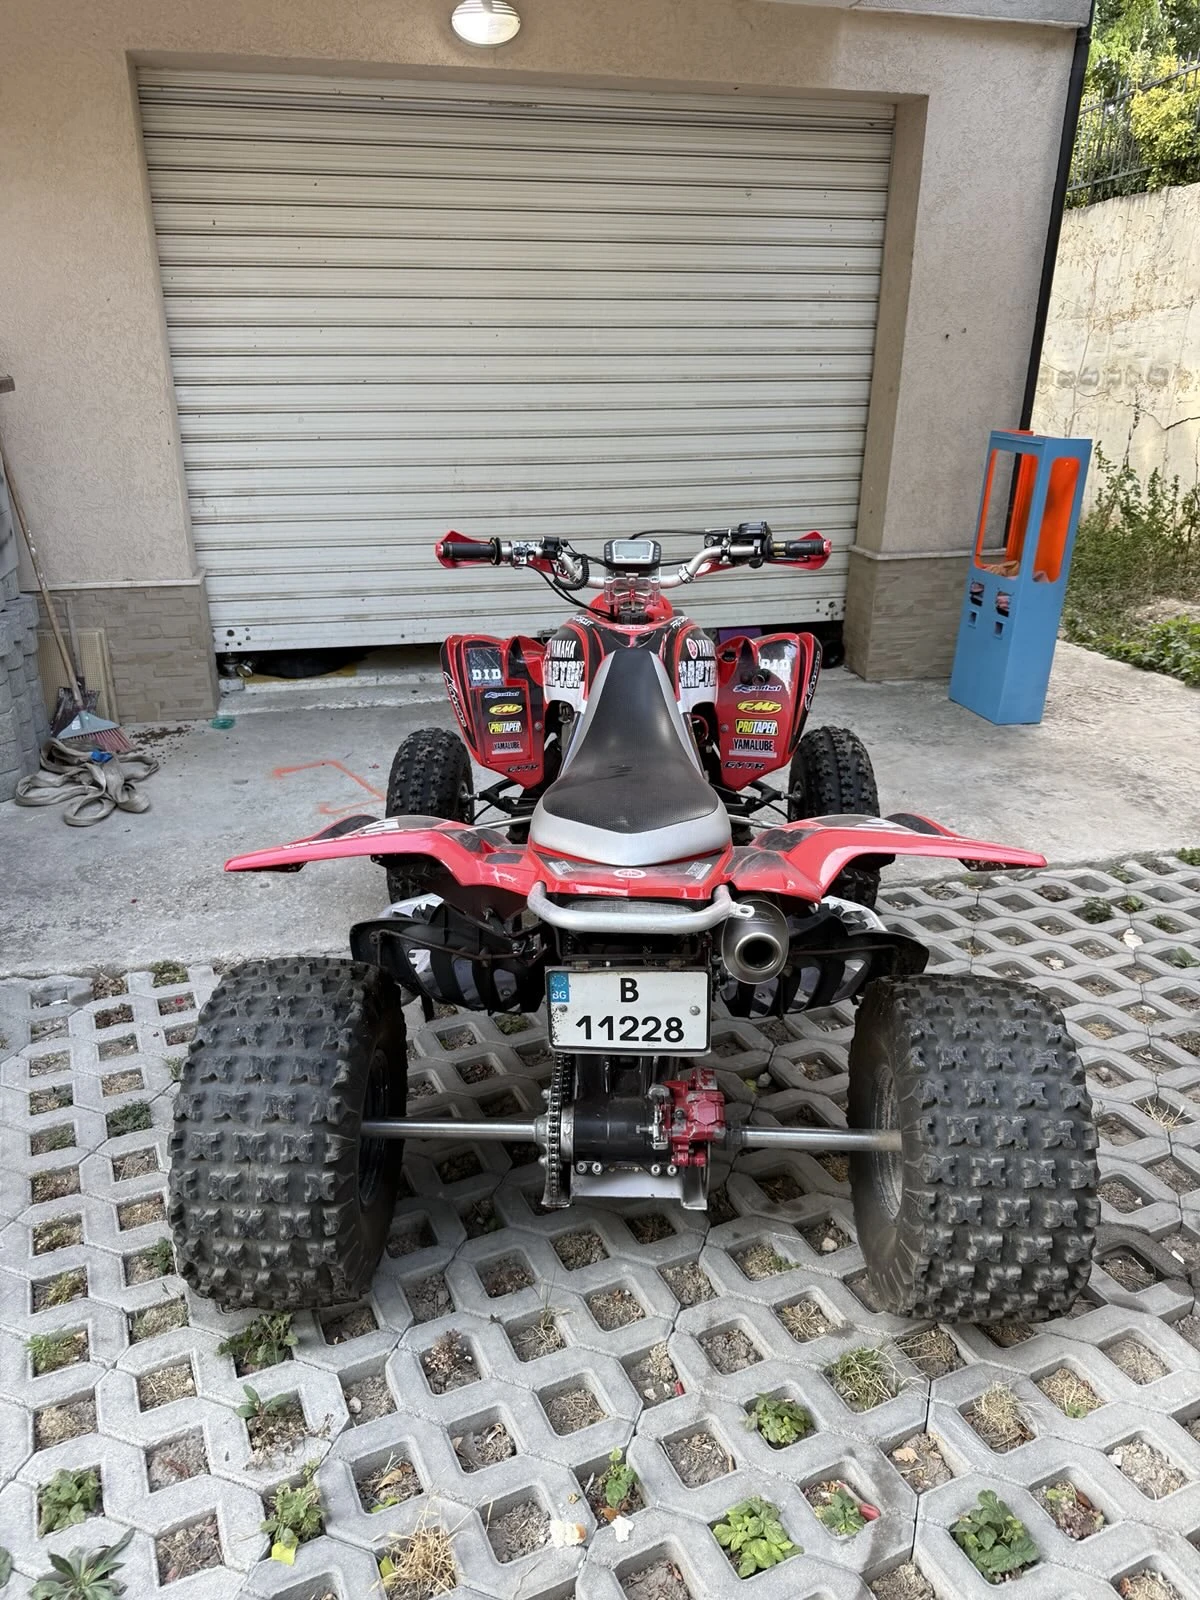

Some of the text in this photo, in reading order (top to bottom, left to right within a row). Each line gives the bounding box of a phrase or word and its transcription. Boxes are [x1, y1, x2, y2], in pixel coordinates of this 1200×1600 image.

[733, 738, 774, 751] YAMALUBE
[552, 990, 567, 1000] BG
[620, 977, 639, 1003] B
[575, 1015, 685, 1043] 11228
